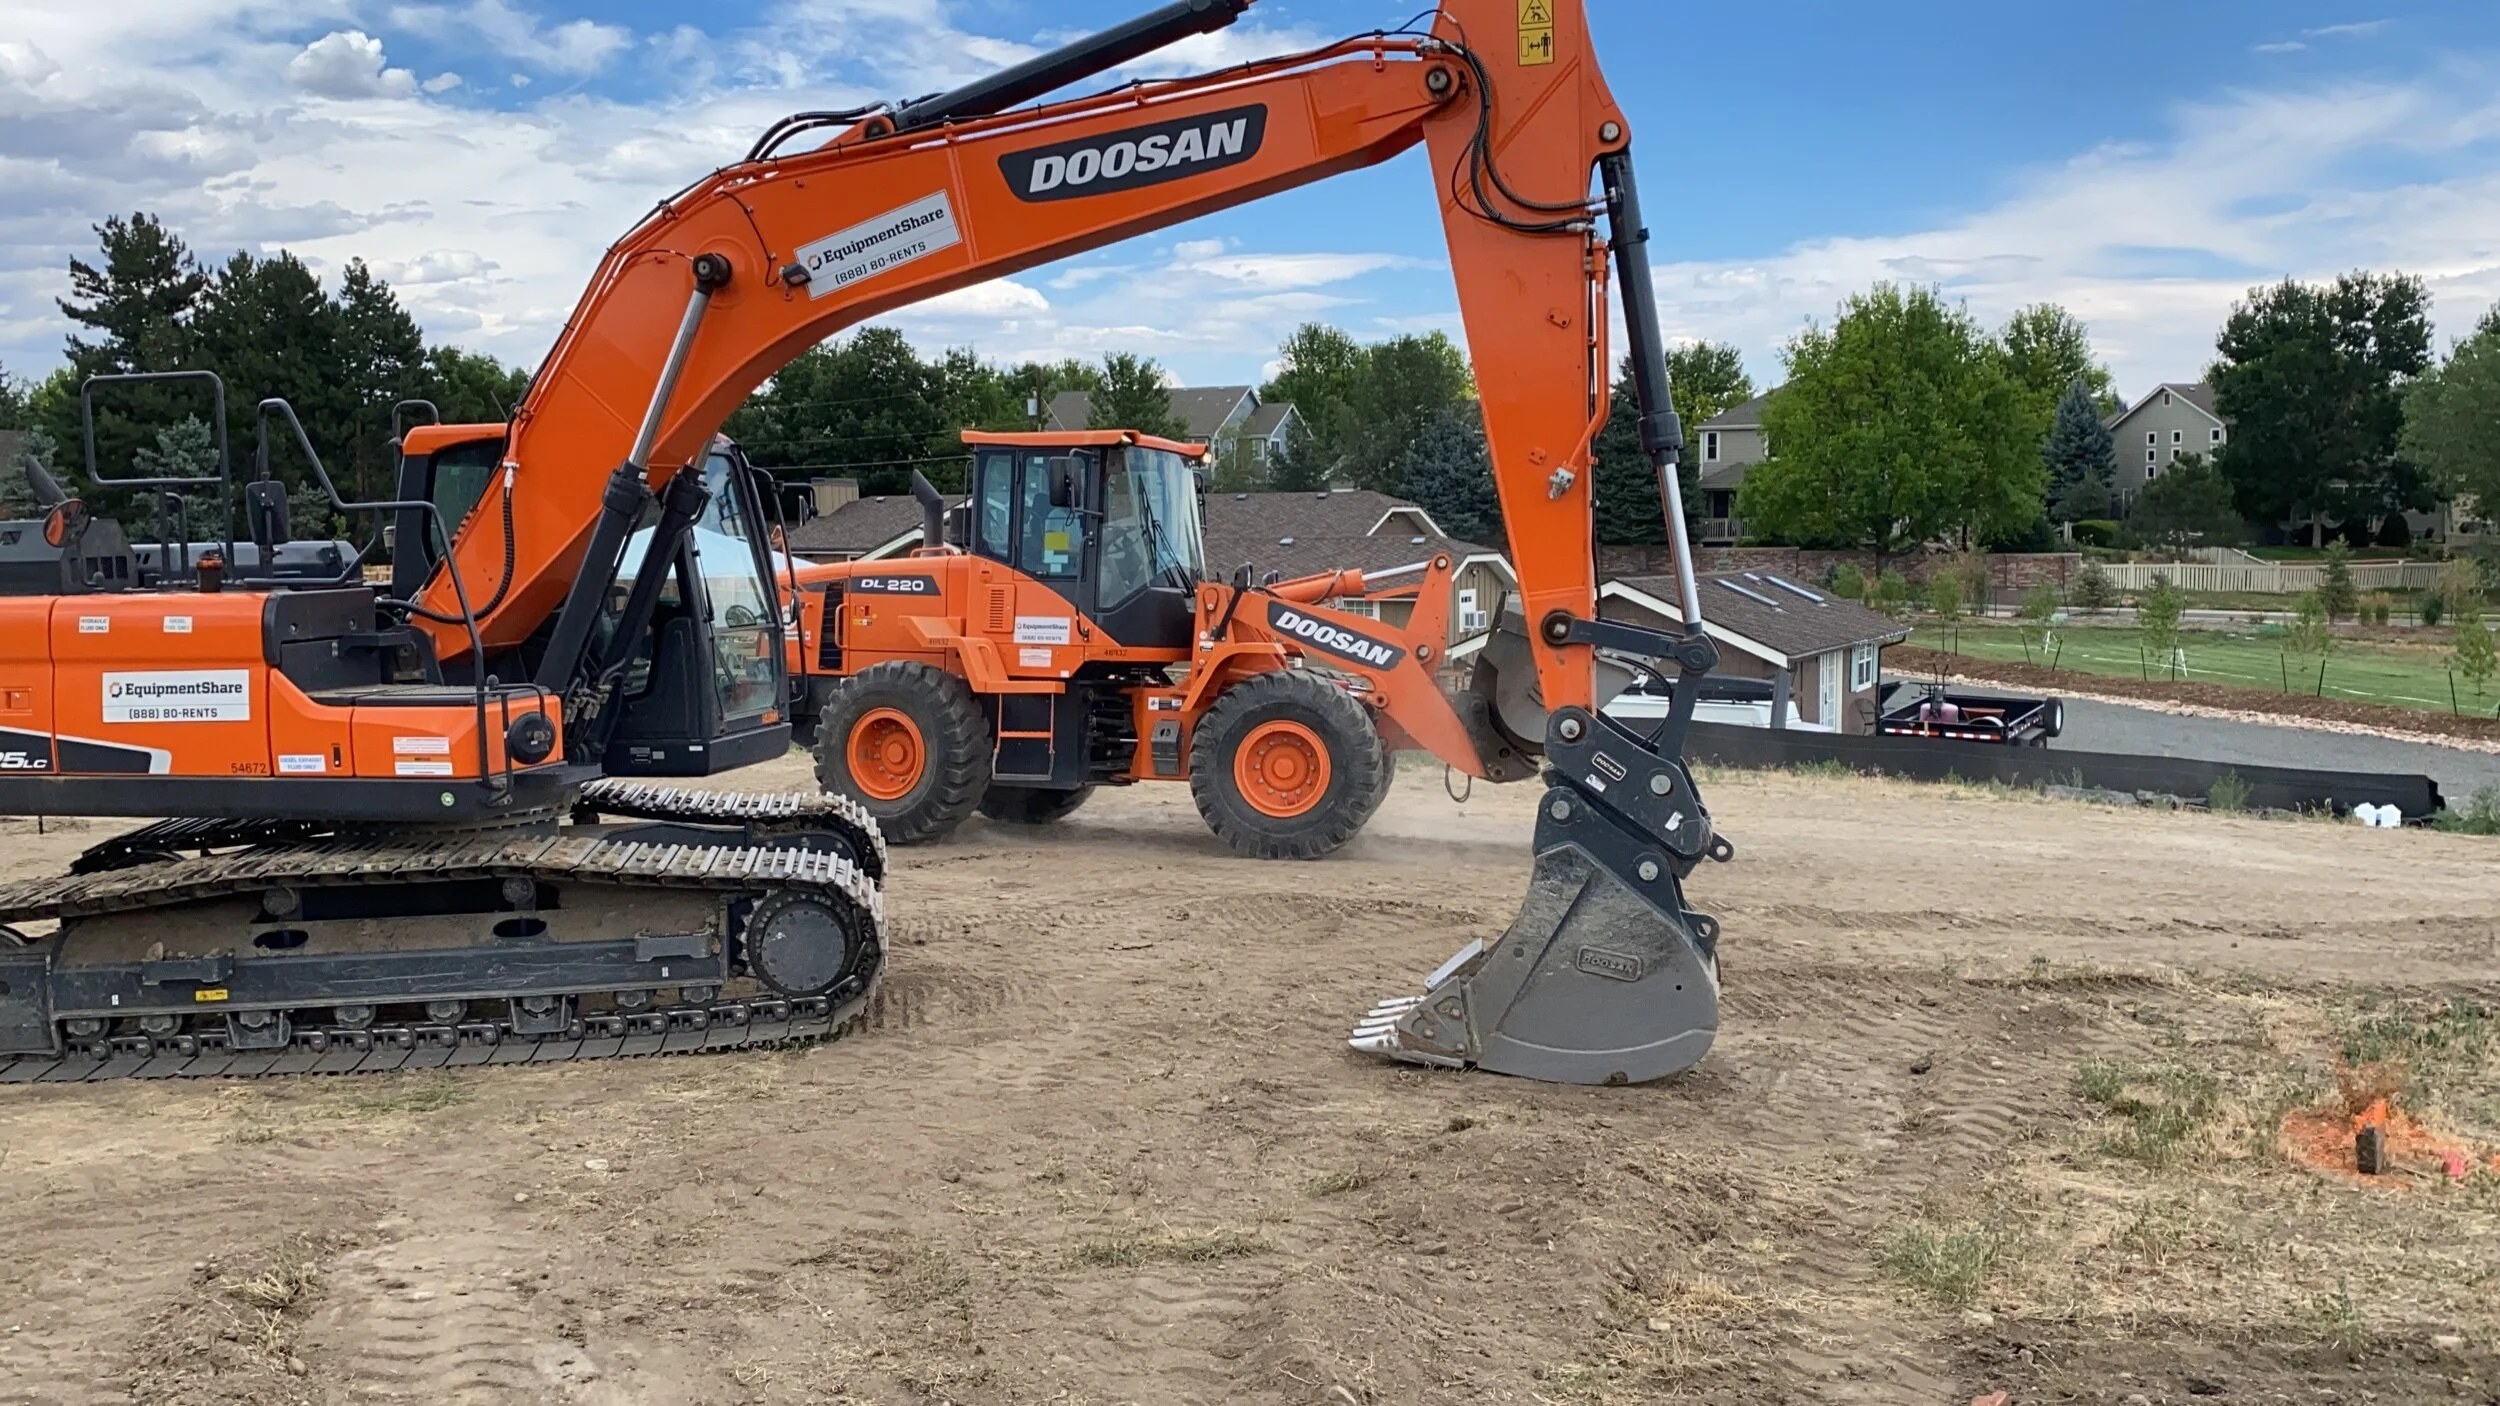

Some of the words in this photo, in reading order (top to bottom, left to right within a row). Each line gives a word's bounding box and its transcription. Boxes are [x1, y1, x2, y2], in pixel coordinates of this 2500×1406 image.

[1029, 118, 1247, 193] DOOSAN
[823, 208, 944, 263] EquipmentShare
[835, 263, 868, 285] (888)
[870, 241, 927, 271] 80-RENTS
[861, 579, 884, 588] DL
[887, 580, 924, 591] 220
[1276, 611, 1393, 665] DOOSAN
[125, 682, 243, 698] EquipmentShare
[129, 709, 160, 719] (888)
[163, 708, 218, 718] 80-RENTS
[1596, 756, 1622, 776] DOOSAN
